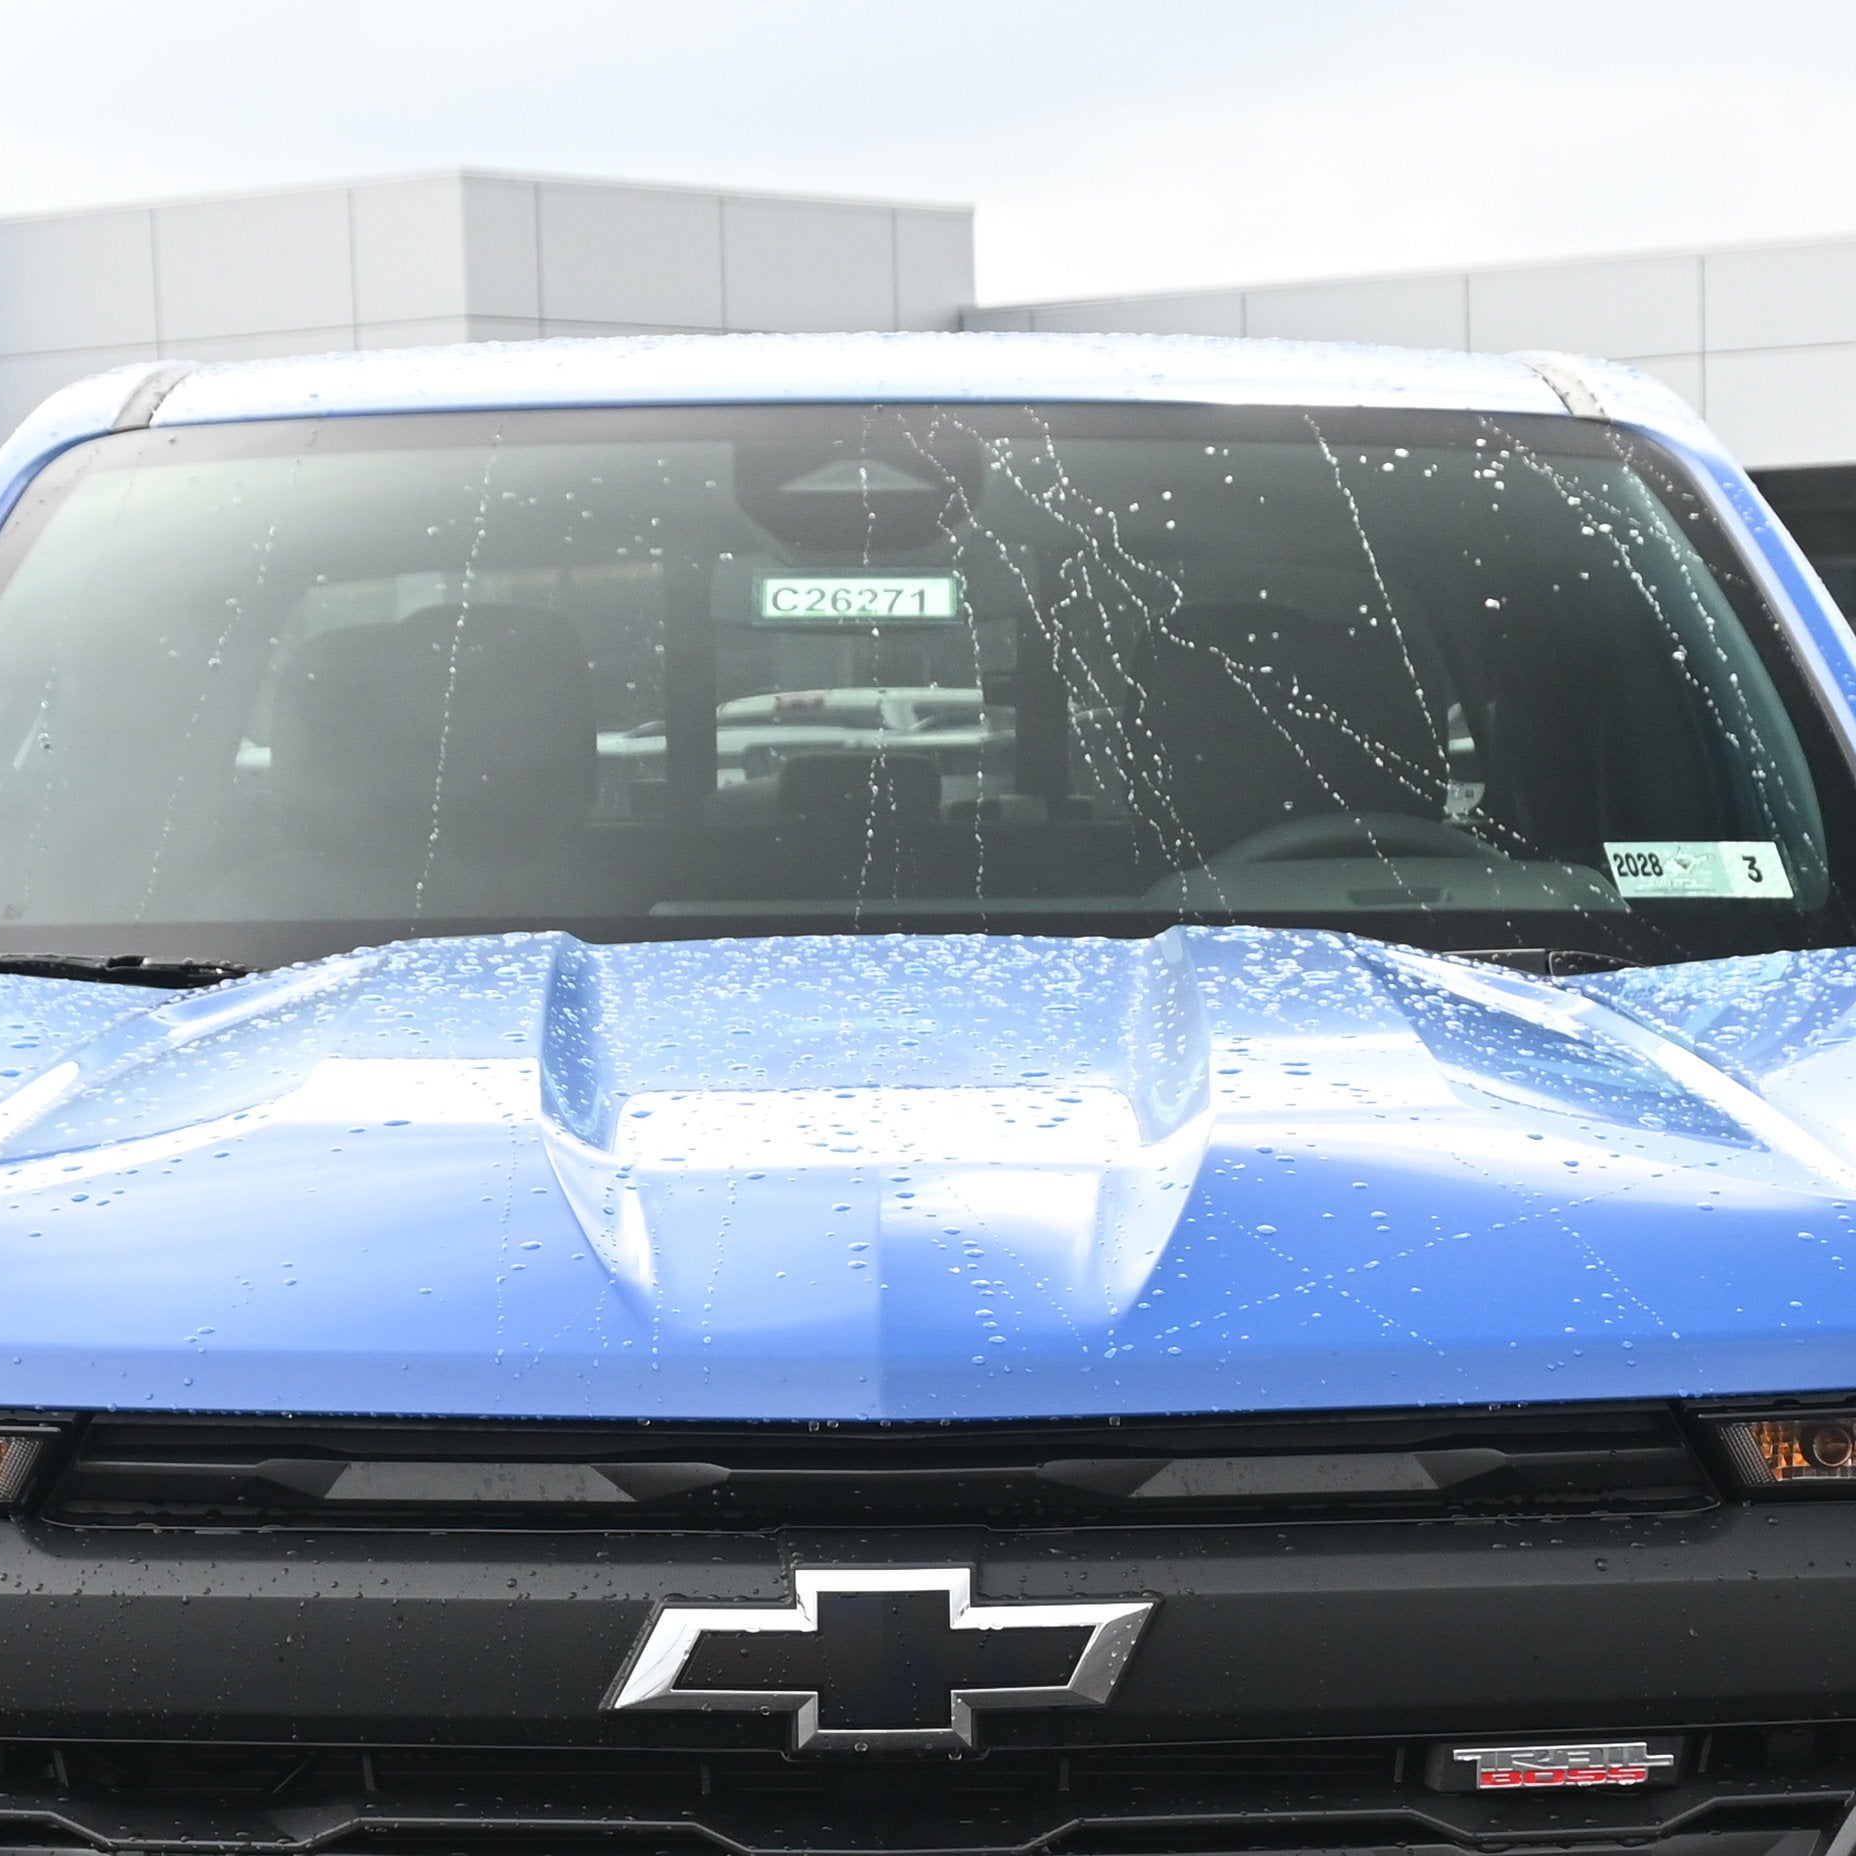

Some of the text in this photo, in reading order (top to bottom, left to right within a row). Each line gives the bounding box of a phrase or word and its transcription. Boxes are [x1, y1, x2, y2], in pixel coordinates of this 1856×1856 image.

[771, 586, 927, 616] C26271
[1613, 852, 1763, 883] 2028 3
[1477, 1767, 1647, 1788] BOSS
